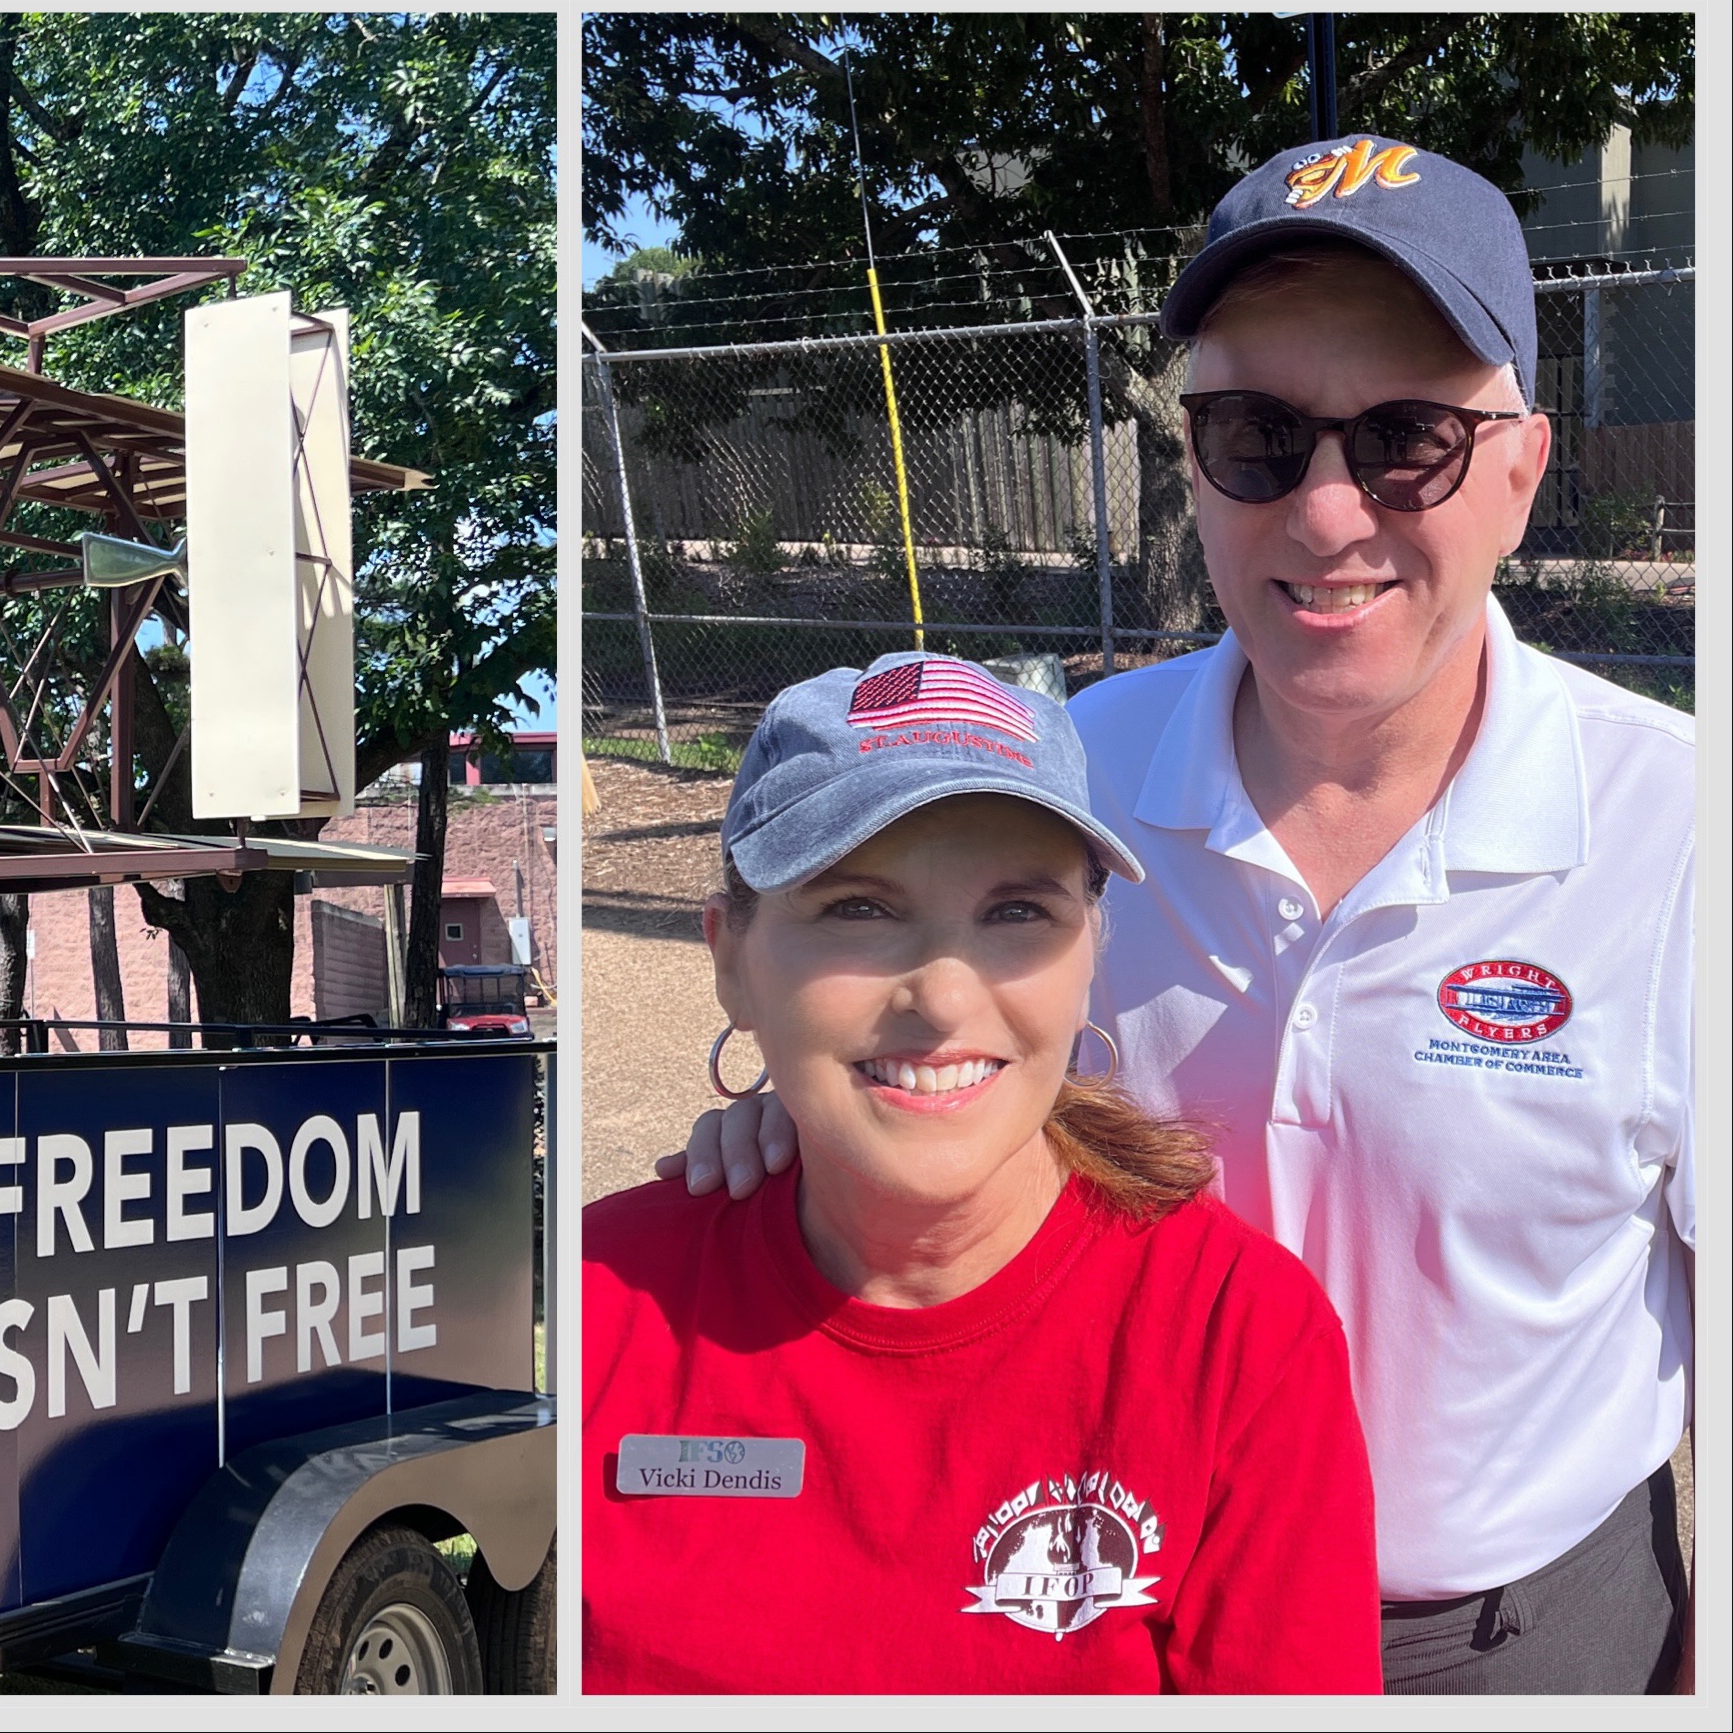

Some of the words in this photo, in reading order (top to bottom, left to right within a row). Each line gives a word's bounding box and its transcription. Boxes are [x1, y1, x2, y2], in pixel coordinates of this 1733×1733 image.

[1461, 965, 1556, 989] WRIGHT
[1458, 1014, 1547, 1039] FLYERS
[1414, 1051, 1483, 1068] CHAMBER
[1485, 1059, 1504, 1069] OF
[1505, 1061, 1584, 1079] COMMERCE
[1429, 1039, 1529, 1059] MONTGOMERY
[1532, 1050, 1571, 1065] AREA
[246, 1244, 438, 1383] FREE
[639, 1468, 695, 1488] Vicki
[703, 1469, 782, 1490] Dendis
[1021, 1572, 1094, 1598] IFOP
